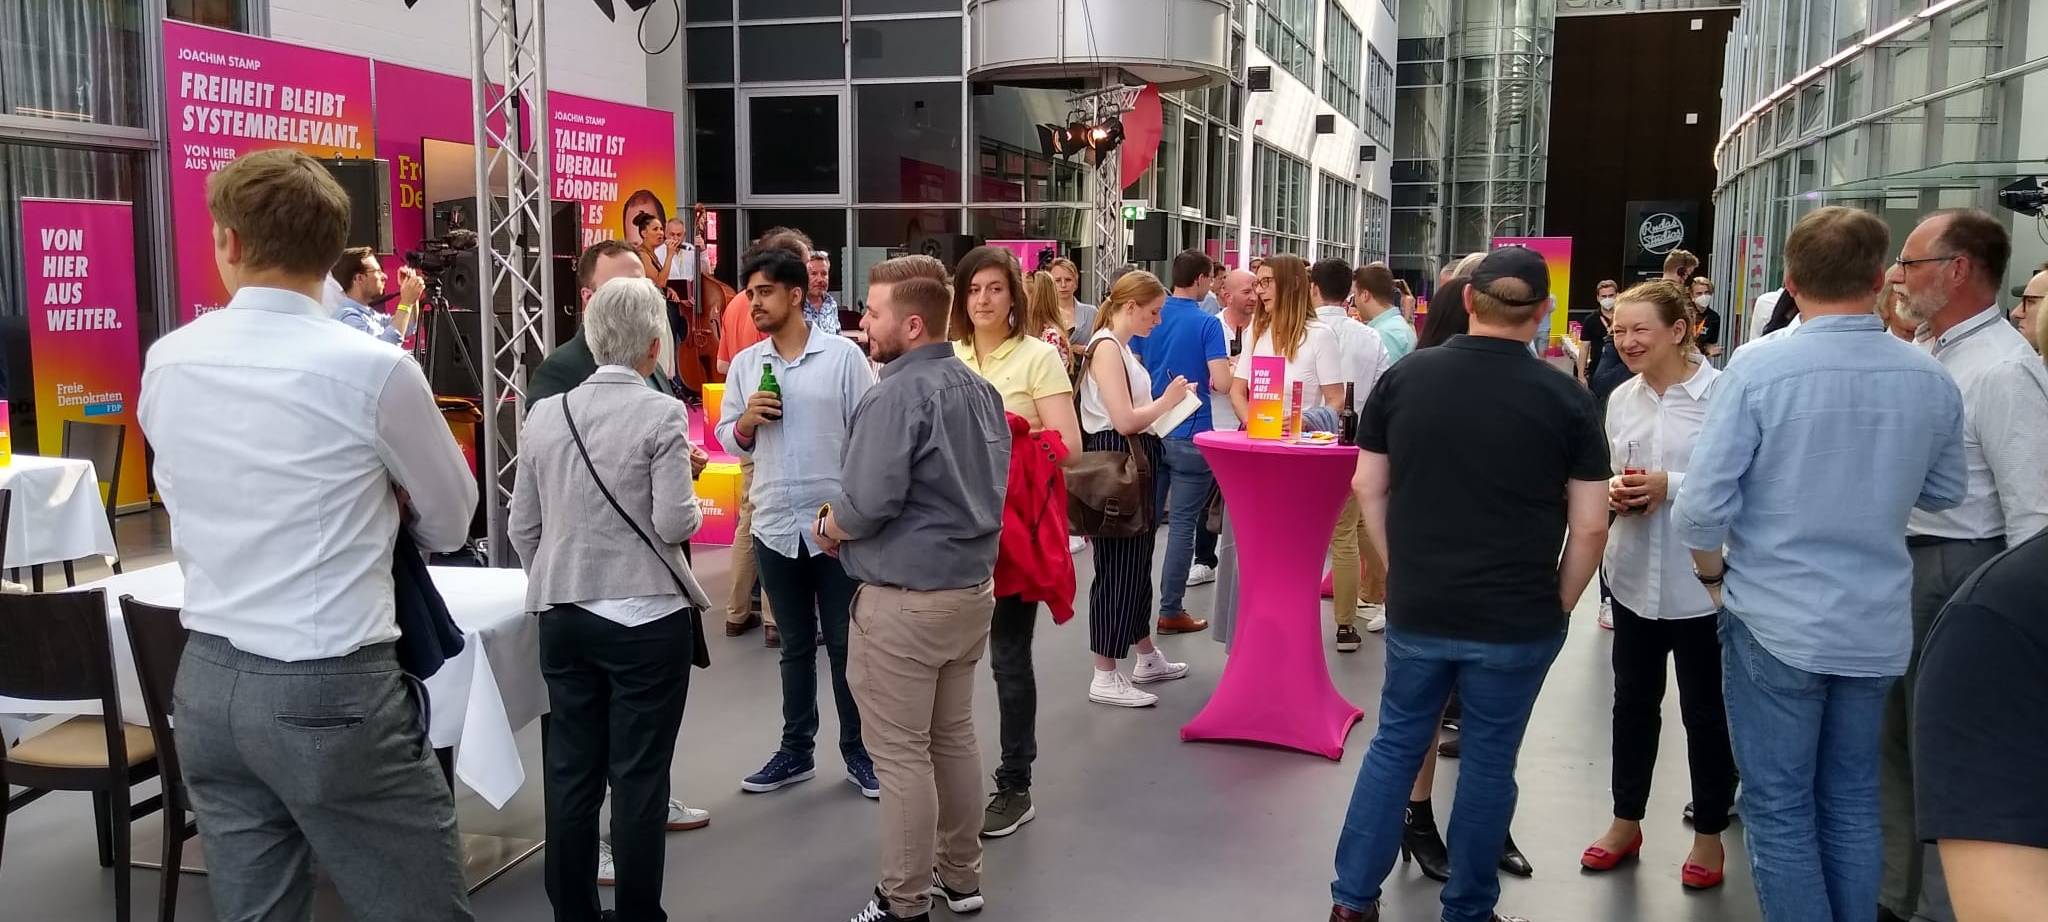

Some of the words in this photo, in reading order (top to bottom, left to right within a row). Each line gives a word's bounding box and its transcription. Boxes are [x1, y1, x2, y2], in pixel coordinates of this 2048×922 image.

[178, 48, 226, 66] JOACHIM
[228, 56, 261, 71] STAMP
[180, 72, 275, 109] FREIHEIT
[280, 87, 346, 118] BLEIBT
[182, 105, 362, 150] SYSTEMRELEVANT.
[554, 112, 584, 124] JOACHIM
[585, 116, 606, 126] STAMP
[183, 144, 210, 157] VON
[212, 146, 236, 160] HIER
[555, 128, 603, 153] TALENT
[606, 135, 625, 156] IST
[185, 158, 208, 170] AUS
[398, 155, 422, 181] Fr
[555, 149, 617, 178] ÜBERALL.
[556, 174, 618, 202] FÖRDERN
[589, 204, 604, 224] ES
[41, 228, 83, 251] VON
[43, 255, 89, 278] HIER
[44, 282, 83, 305] AUS
[46, 308, 122, 332] WEITER.
[1254, 369, 1270, 377] VON
[56, 382, 84, 395] Freie
[57, 391, 123, 407] Demokraten
[106, 403, 122, 413] FDP
[702, 507, 725, 516] EITER.
